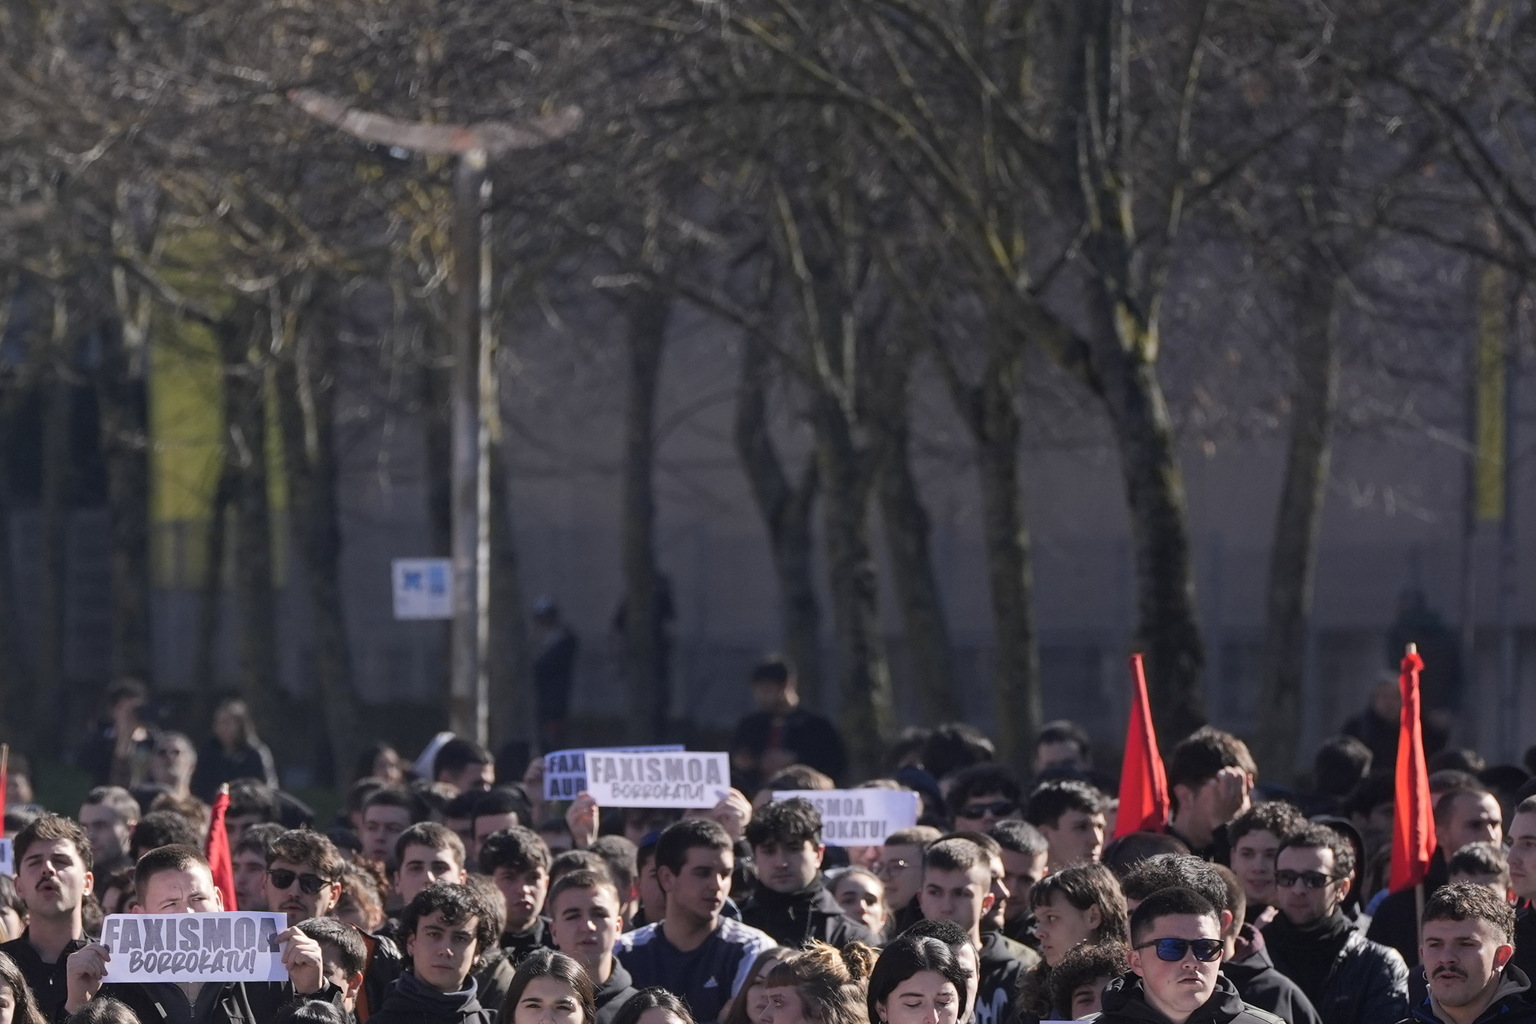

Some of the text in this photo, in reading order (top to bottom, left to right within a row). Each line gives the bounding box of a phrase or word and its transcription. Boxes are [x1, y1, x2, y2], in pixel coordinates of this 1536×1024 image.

[591, 757, 722, 785] FAXISMOA
[550, 778, 587, 797] AUR
[815, 798, 865, 816] SMOA
[825, 820, 887, 838] OKATU!
[104, 917, 281, 954] FAXISMOA
[129, 949, 257, 974] BORROKATU!
